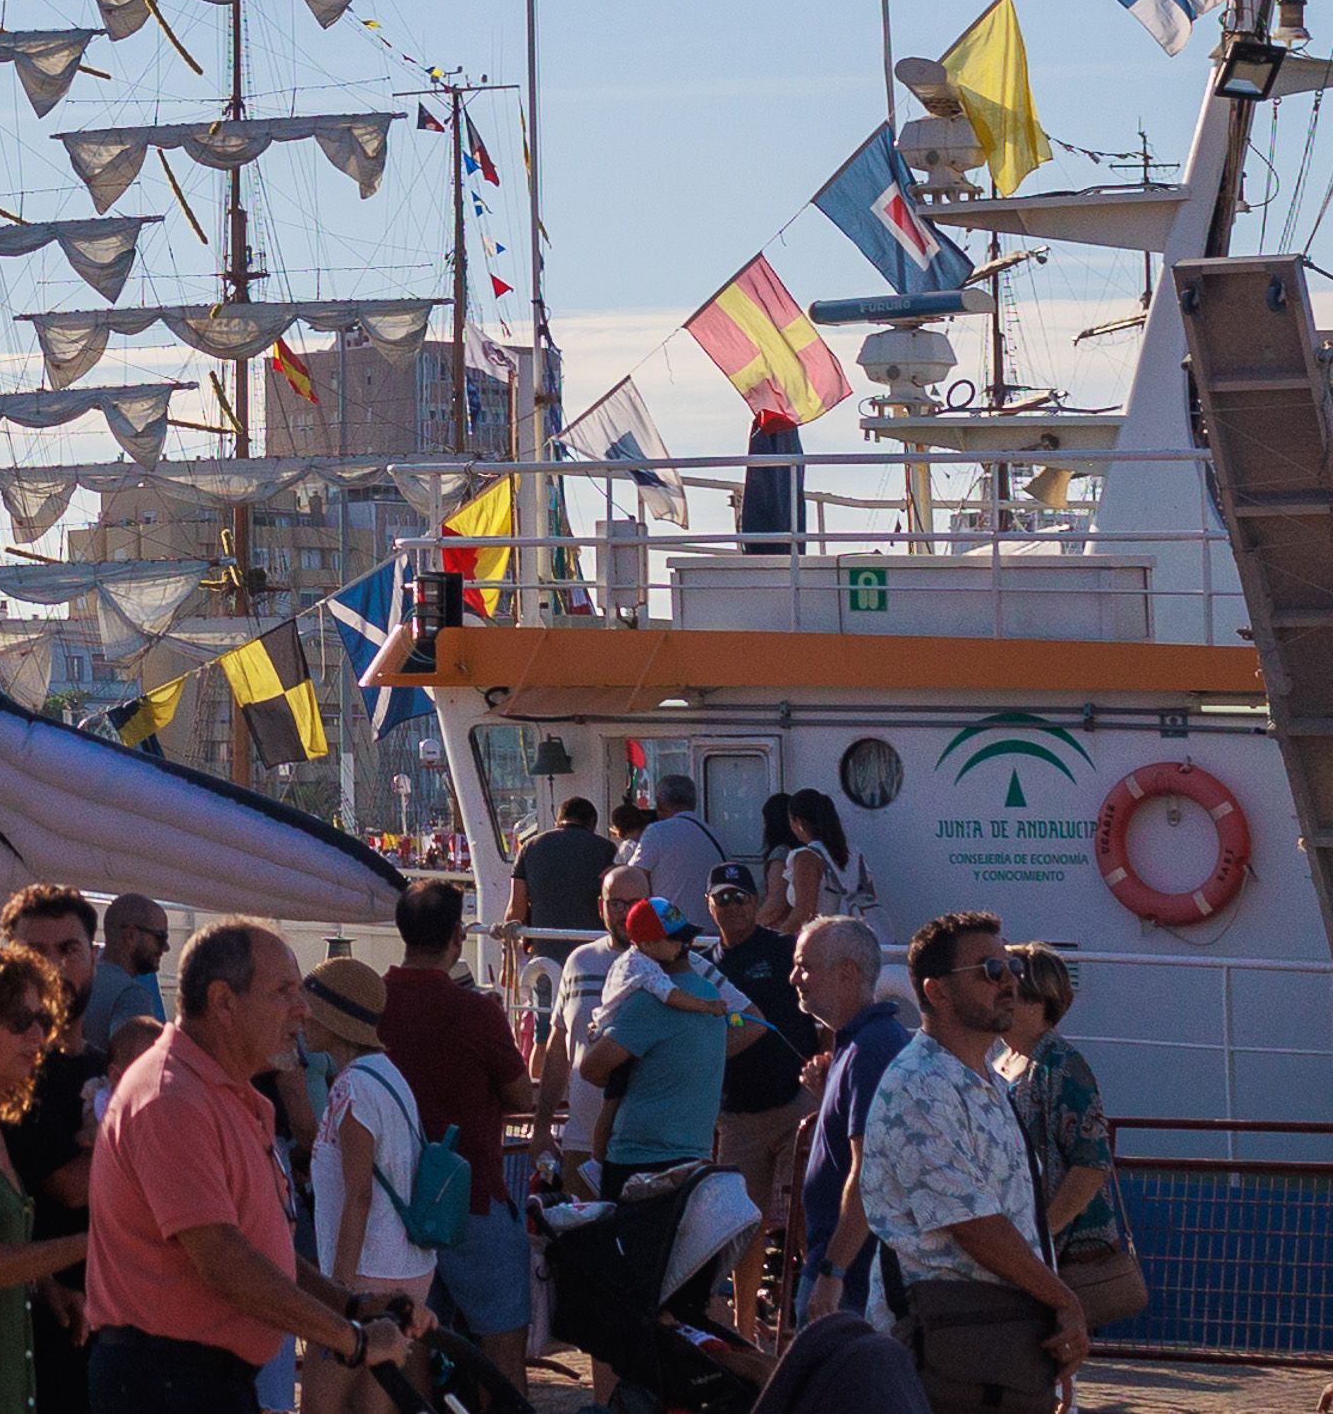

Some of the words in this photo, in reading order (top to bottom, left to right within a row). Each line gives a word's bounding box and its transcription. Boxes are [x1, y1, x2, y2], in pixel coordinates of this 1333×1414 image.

[859, 300, 911, 313] FURUNO
[935, 820, 983, 838] JUNTA
[990, 820, 1009, 838] DE
[949, 852, 1011, 865] CONSEJERÍA
[1014, 853, 1028, 865] DE
[1030, 852, 1089, 865] ECONOMÍA
[973, 870, 981, 881] Y
[983, 870, 1065, 882] CONOCIMIENTO
